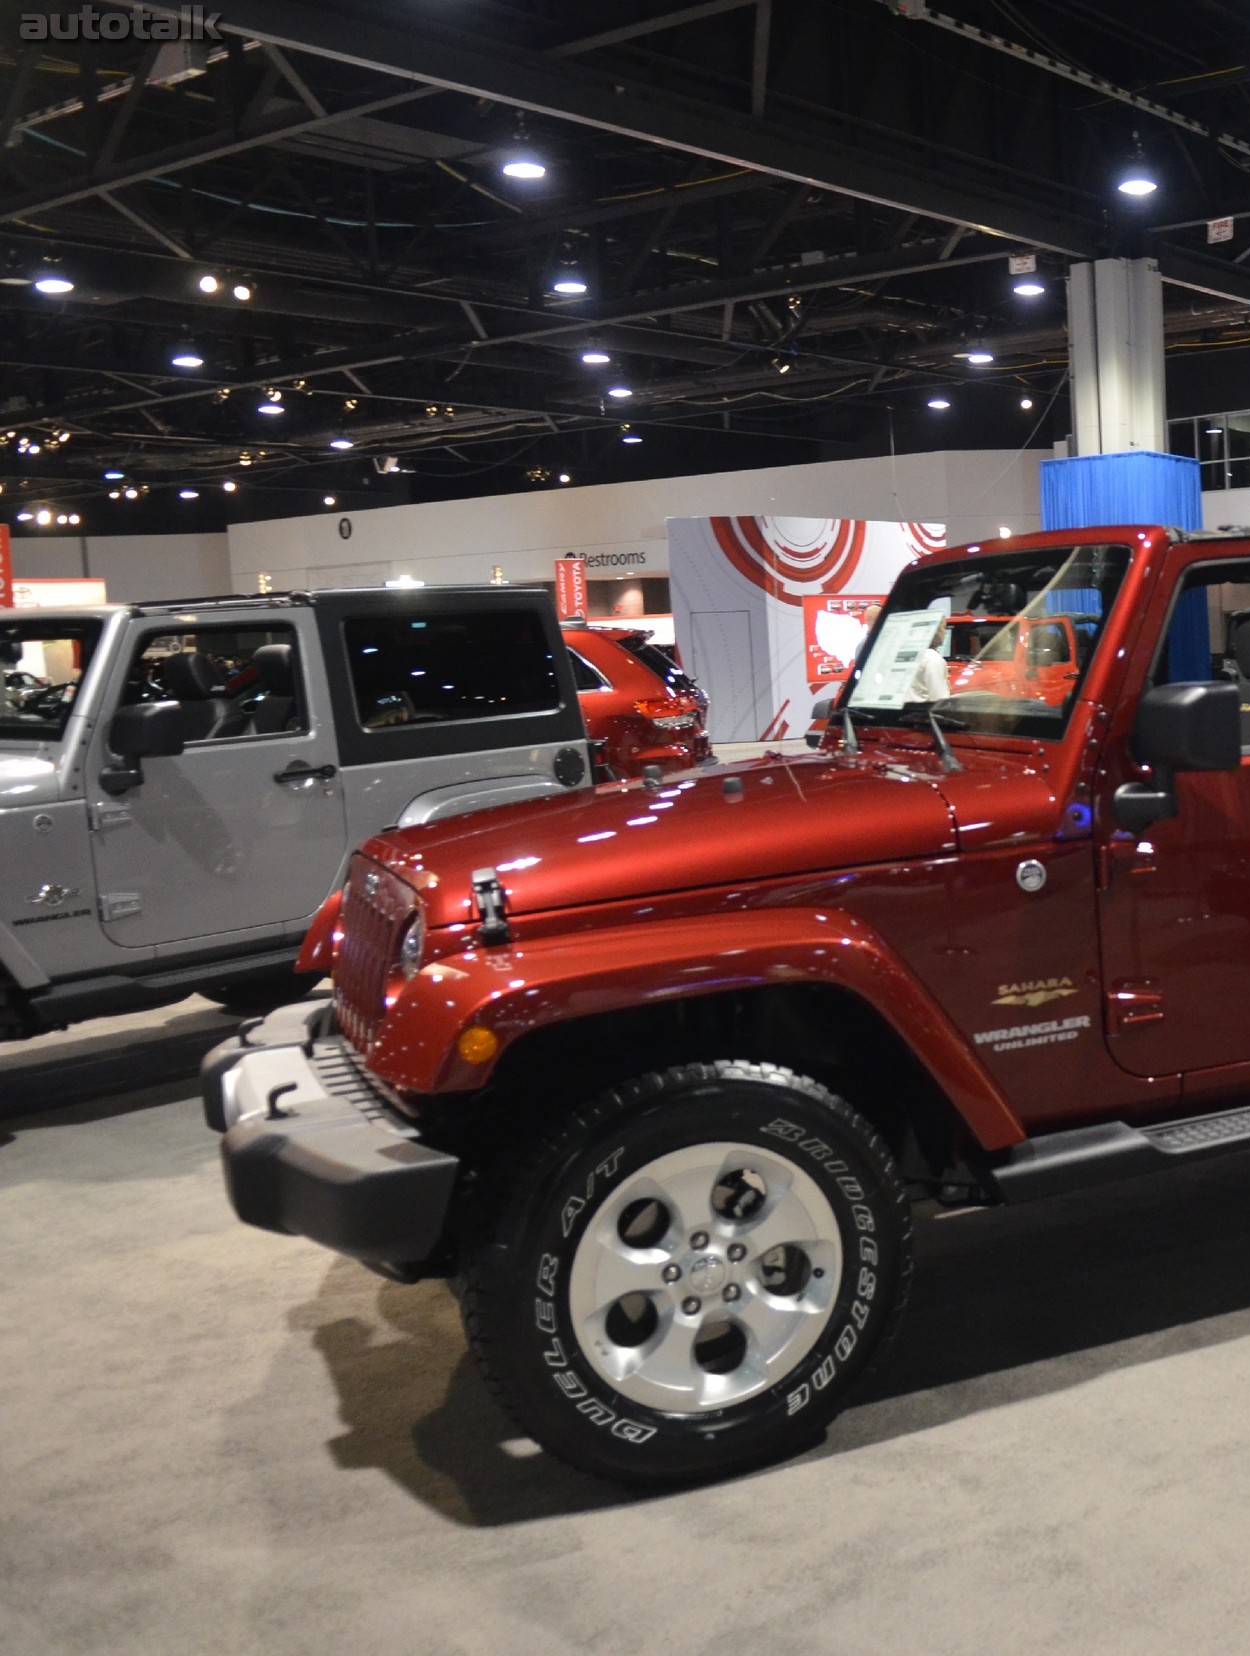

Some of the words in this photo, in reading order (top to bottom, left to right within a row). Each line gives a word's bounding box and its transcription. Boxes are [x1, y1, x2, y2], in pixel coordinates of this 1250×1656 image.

[571, 562, 584, 607] TOYOTA
[998, 977, 1073, 995] SAHARA
[973, 1015, 1091, 1044] WRANGLER
[993, 1031, 1079, 1052] UNLIMITED
[560, 1146, 627, 1238] A/T
[760, 1118, 878, 1416] BRIDGESTONE
[535, 1253, 658, 1444] DUELER
